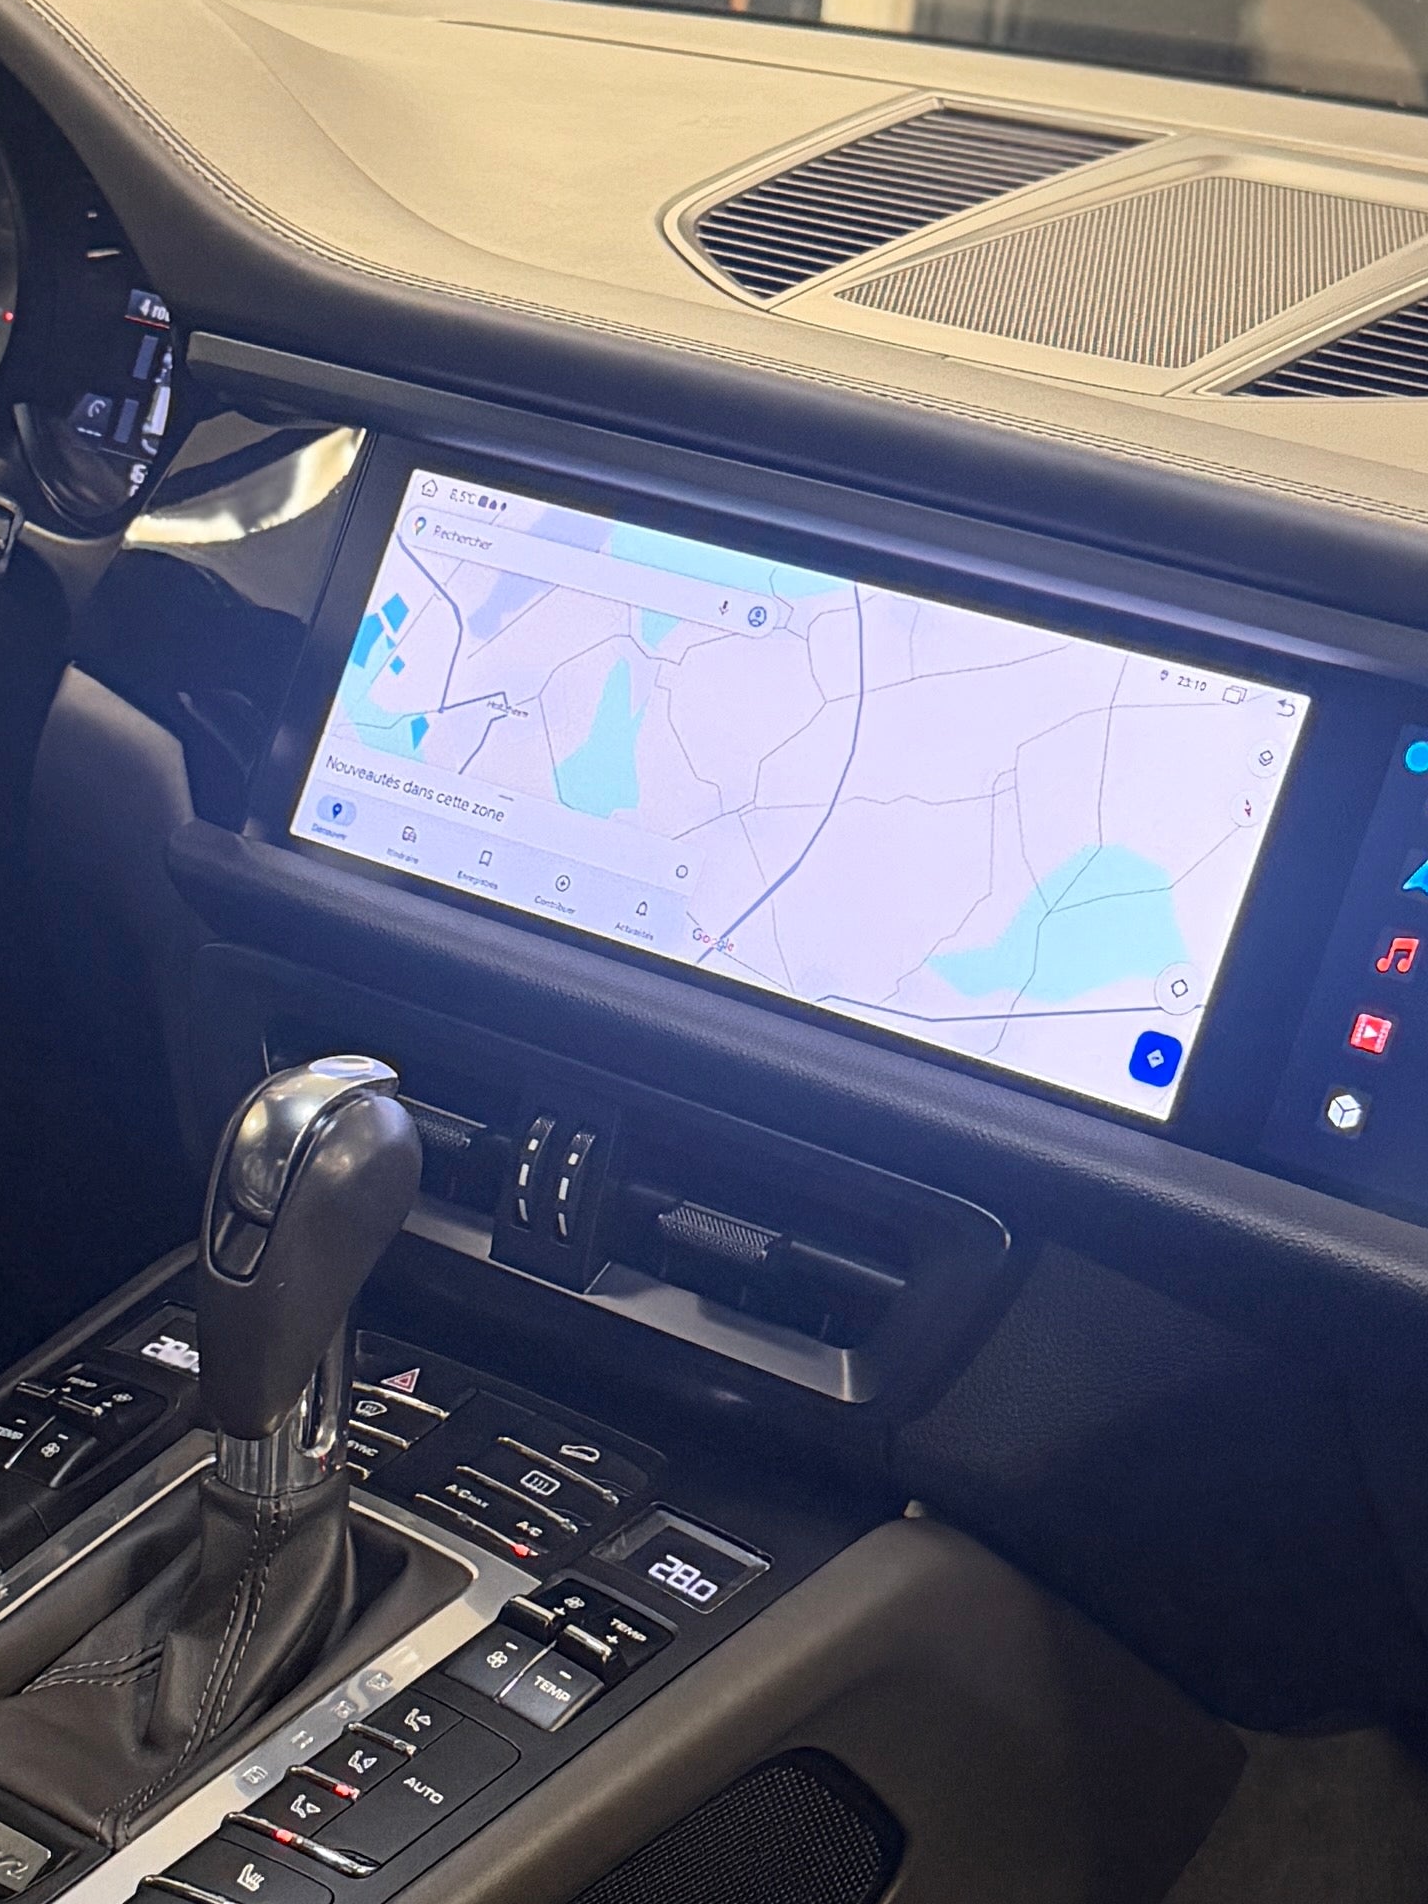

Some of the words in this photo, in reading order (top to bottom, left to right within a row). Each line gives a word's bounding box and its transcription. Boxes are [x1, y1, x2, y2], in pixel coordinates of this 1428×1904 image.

[434, 523, 494, 552] Rechercher
[325, 754, 401, 790] Nouveautés
[402, 779, 435, 801] dans
[436, 789, 469, 810] cette
[470, 802, 506, 823] zone
[691, 926, 736, 953] Google
[647, 1553, 719, 1603] 28.0
[609, 1616, 648, 1643] TEMP
[533, 1674, 572, 1703] TEMP
[402, 1776, 445, 1806] AUTO
